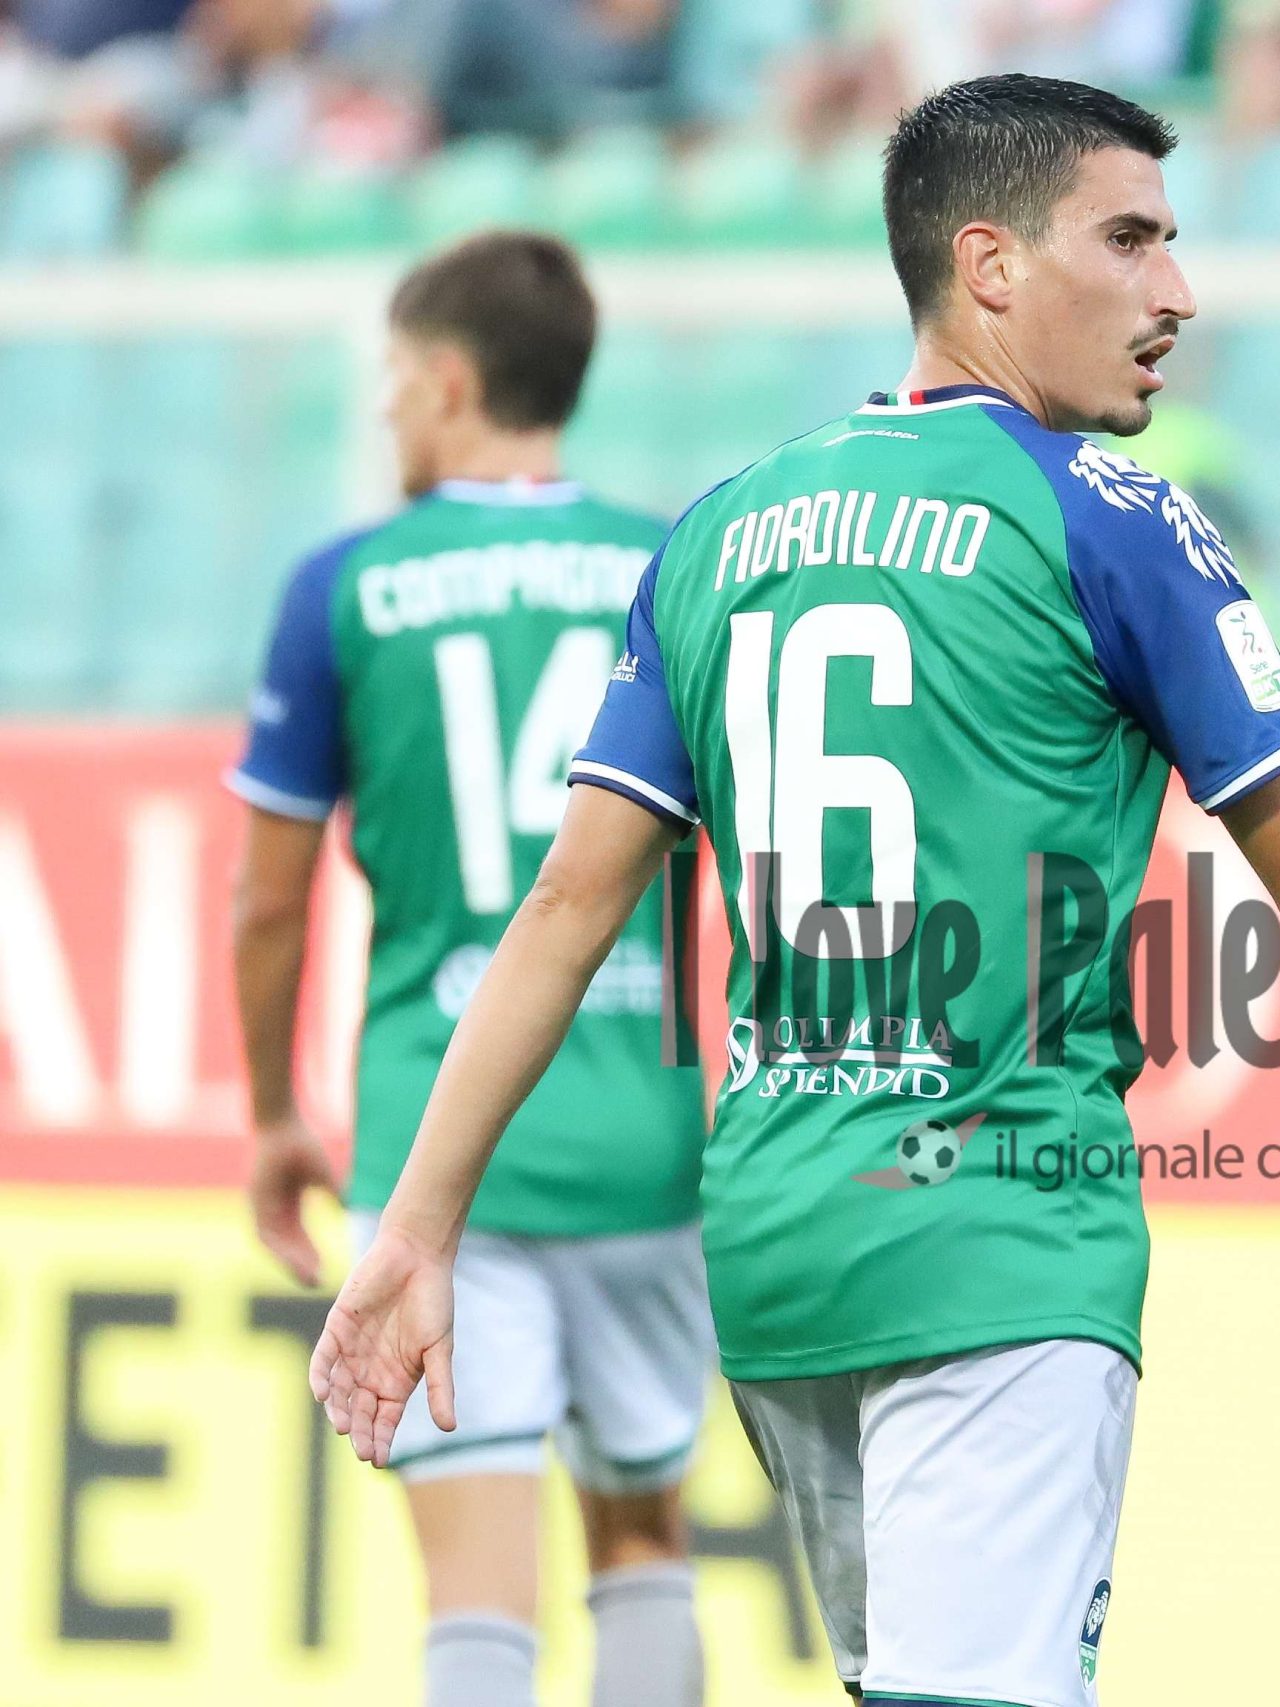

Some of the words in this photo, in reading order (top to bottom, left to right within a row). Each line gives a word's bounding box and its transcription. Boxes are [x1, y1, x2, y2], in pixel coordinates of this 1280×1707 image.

[714, 489, 991, 592] FIORDILINO
[724, 602, 918, 963] 16
[773, 1015, 953, 1050] OLIMPIA
[758, 1064, 950, 1099] SPLENDID
